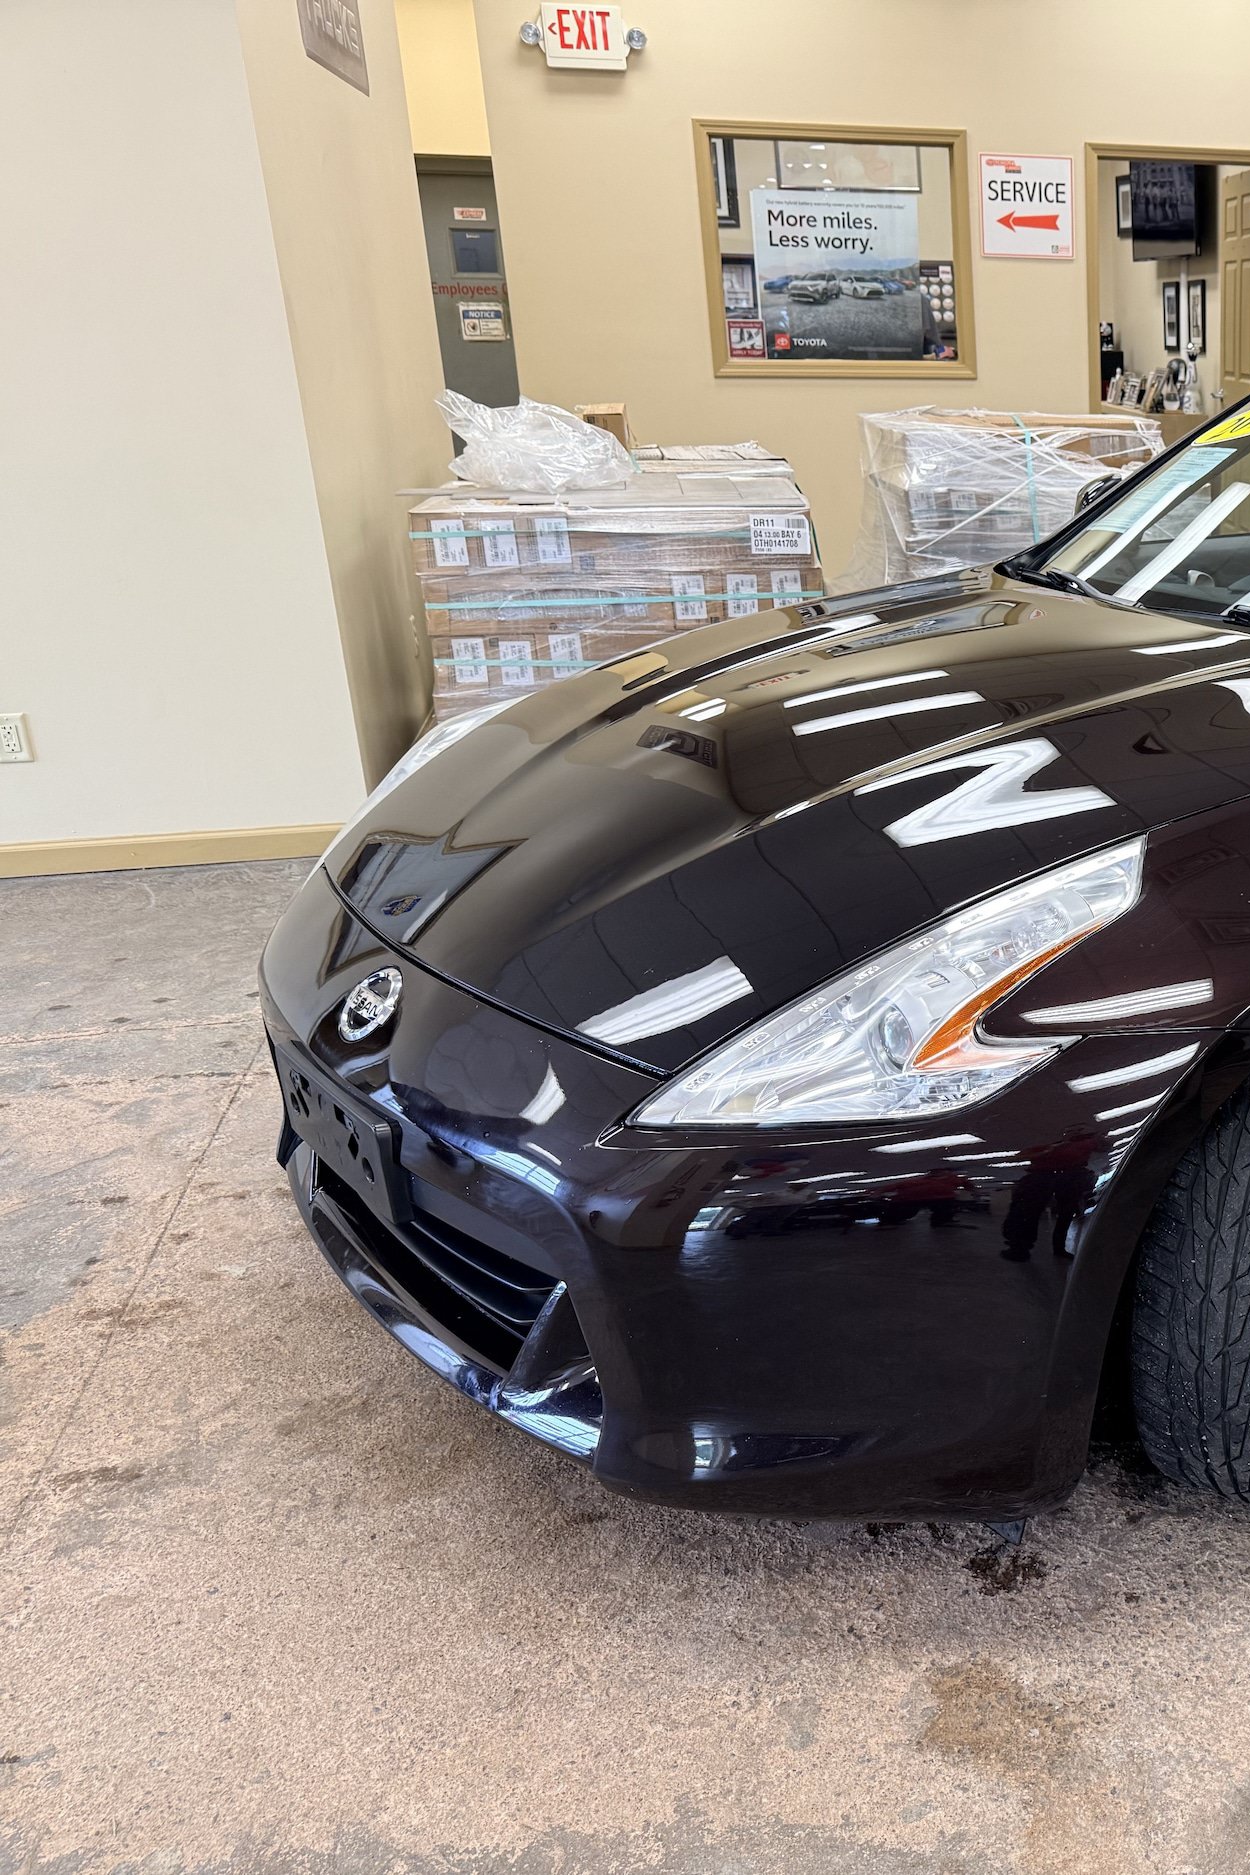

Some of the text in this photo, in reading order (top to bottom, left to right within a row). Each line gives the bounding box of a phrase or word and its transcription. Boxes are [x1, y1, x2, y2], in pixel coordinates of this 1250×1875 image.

[556, 9, 610, 51] EXIT
[987, 180, 1066, 204] SERVICE
[767, 209, 878, 230] More miles.
[768, 230, 874, 254] Less worry.
[432, 282, 498, 298] Employees
[468, 310, 496, 318] NOTICE
[793, 338, 828, 347] TOYOTA
[753, 518, 775, 527] DR11
[781, 530, 795, 538] BAY
